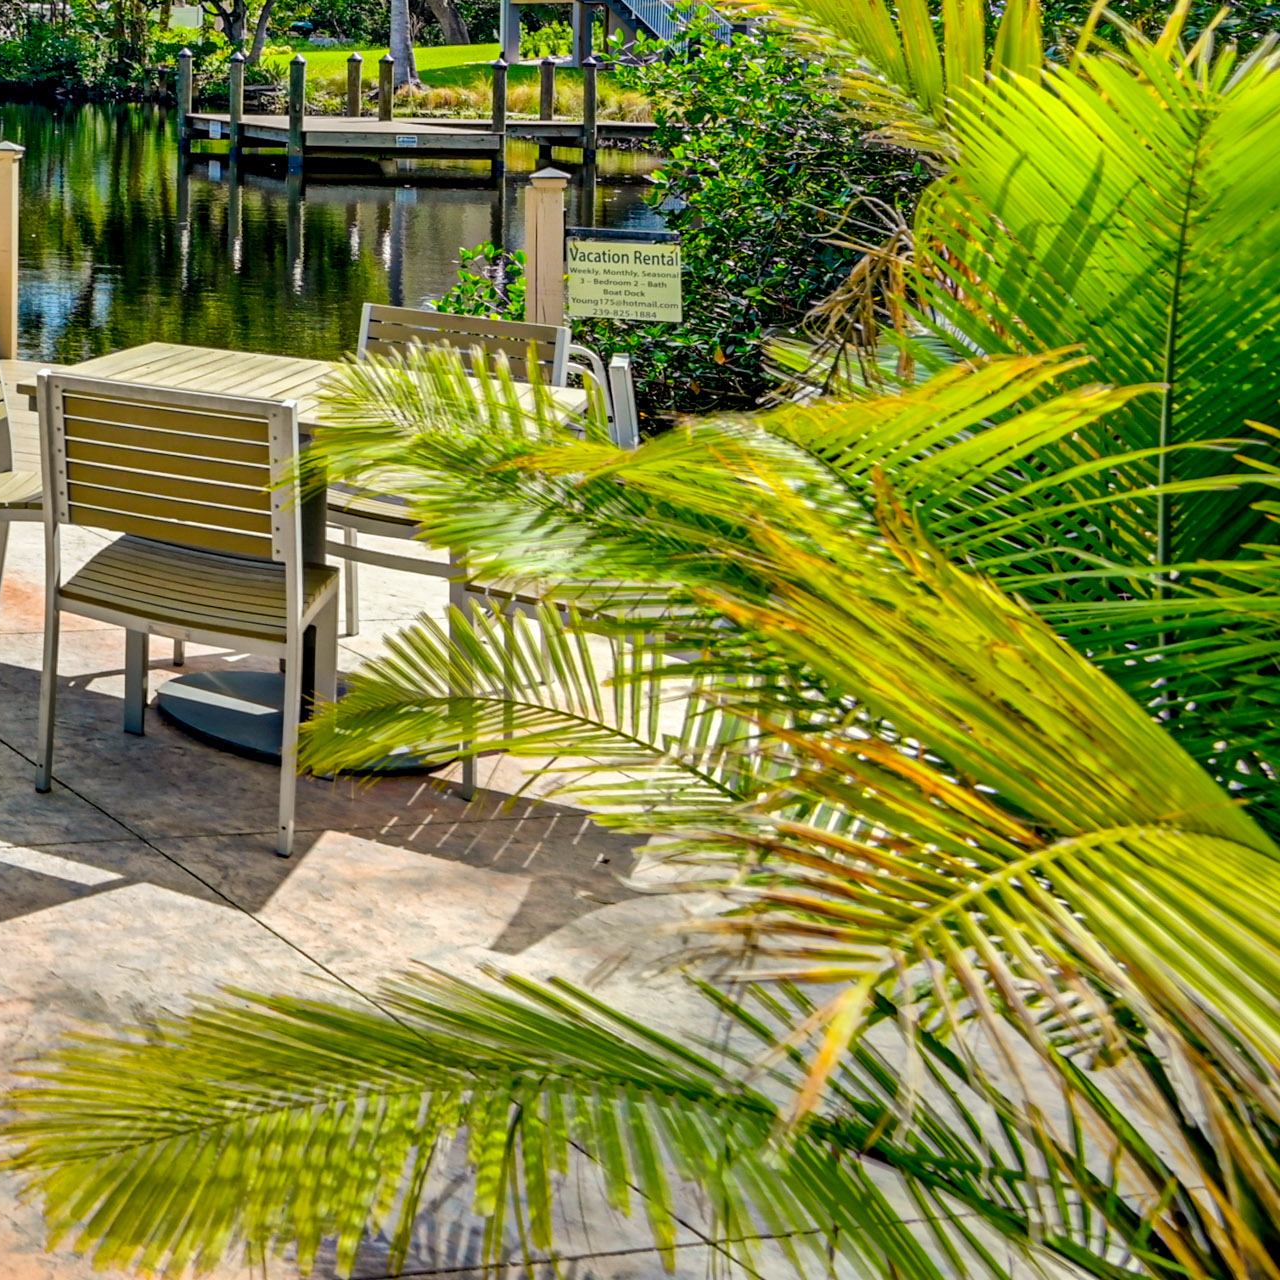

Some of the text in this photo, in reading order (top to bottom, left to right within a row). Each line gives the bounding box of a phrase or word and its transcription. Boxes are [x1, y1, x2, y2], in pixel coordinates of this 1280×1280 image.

[569, 247, 679, 266] Vacation Rental
[569, 267, 601, 276] Weekly,
[603, 269, 639, 277] Monthly,
[593, 278, 632, 286] Bedroom
[571, 297, 679, 309] Young175@hotmail.com
[593, 309, 657, 318] 239-825-1884
